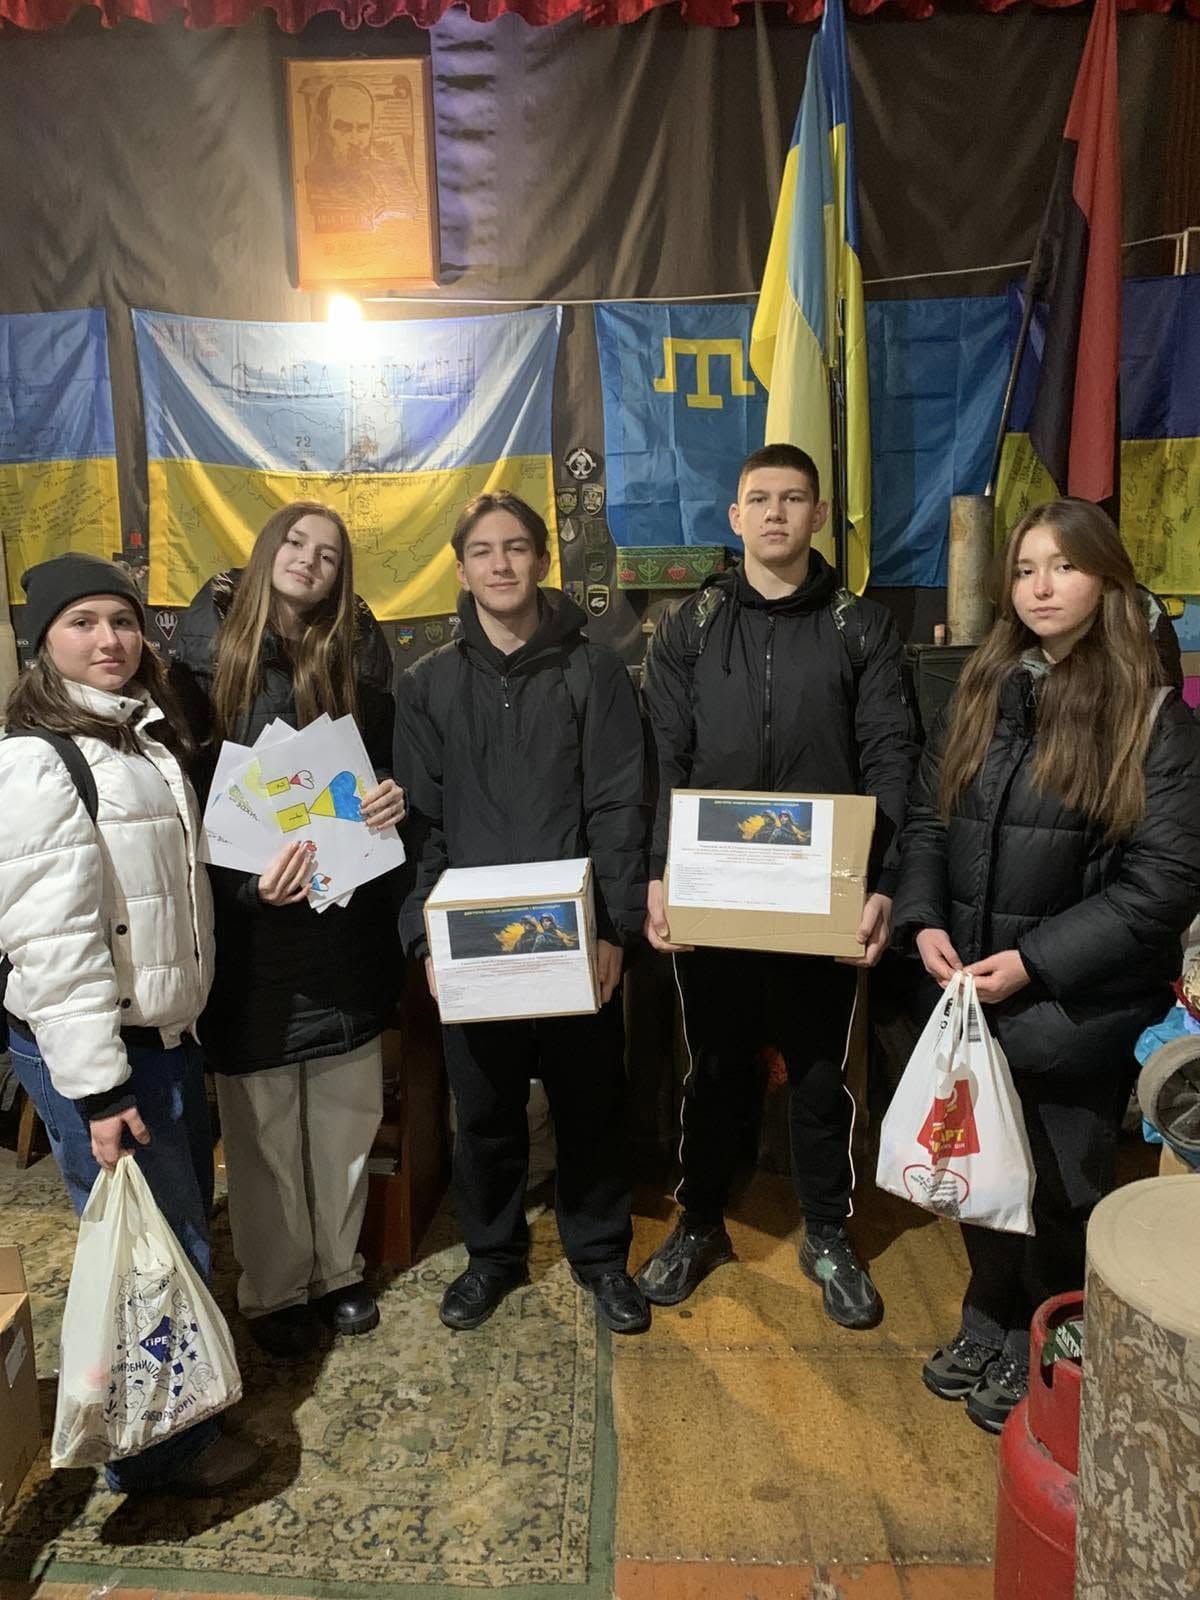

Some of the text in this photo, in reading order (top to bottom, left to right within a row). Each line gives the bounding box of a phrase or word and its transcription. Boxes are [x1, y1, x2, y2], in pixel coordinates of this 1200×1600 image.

[295, 435, 312, 448] 72
[145, 1335, 168, 1347] ПРЕ
[111, 1359, 161, 1383] ВИРОБНИЦТВ
